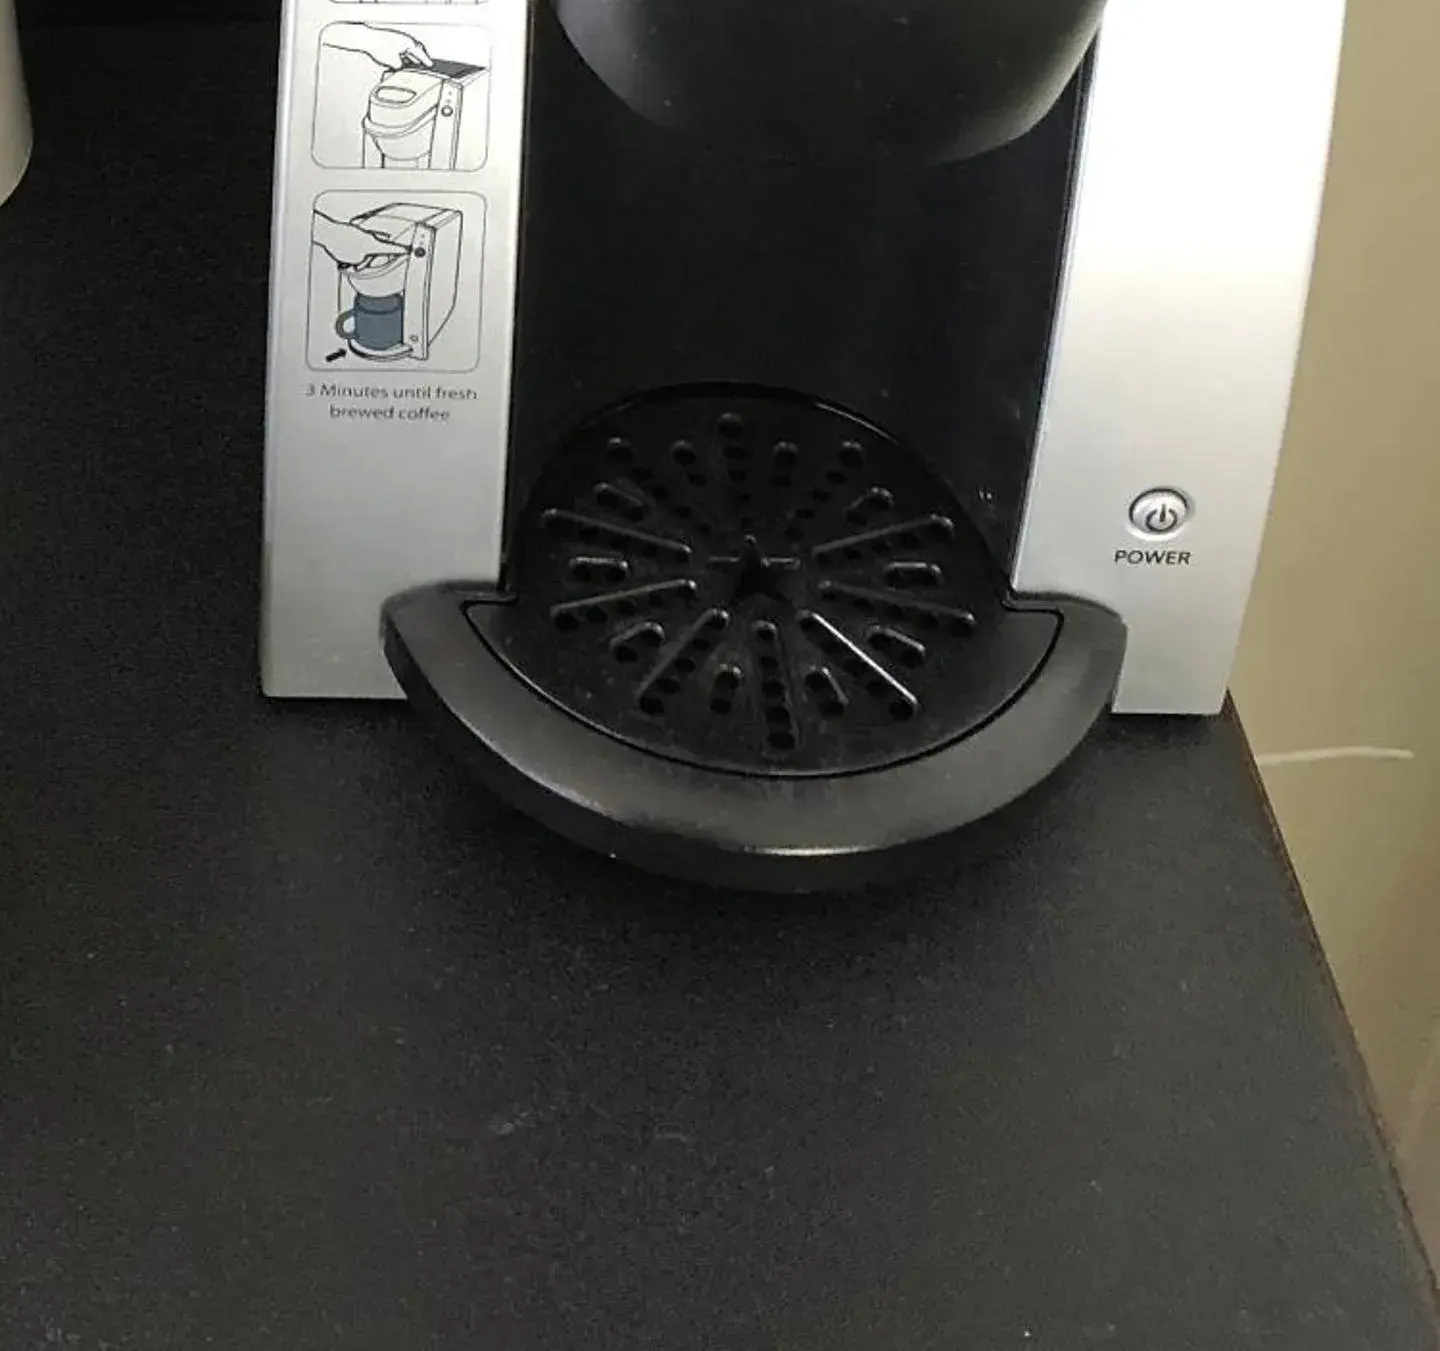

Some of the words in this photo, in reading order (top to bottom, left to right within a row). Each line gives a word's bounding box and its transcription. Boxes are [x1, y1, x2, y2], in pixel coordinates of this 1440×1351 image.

[306, 383, 315, 397] 3
[320, 383, 388, 398] Minutes
[393, 385, 432, 399] until
[436, 386, 477, 400] fresh
[329, 404, 394, 419] brewed
[398, 405, 450, 421] coffee
[1114, 550, 1191, 565] POWER
